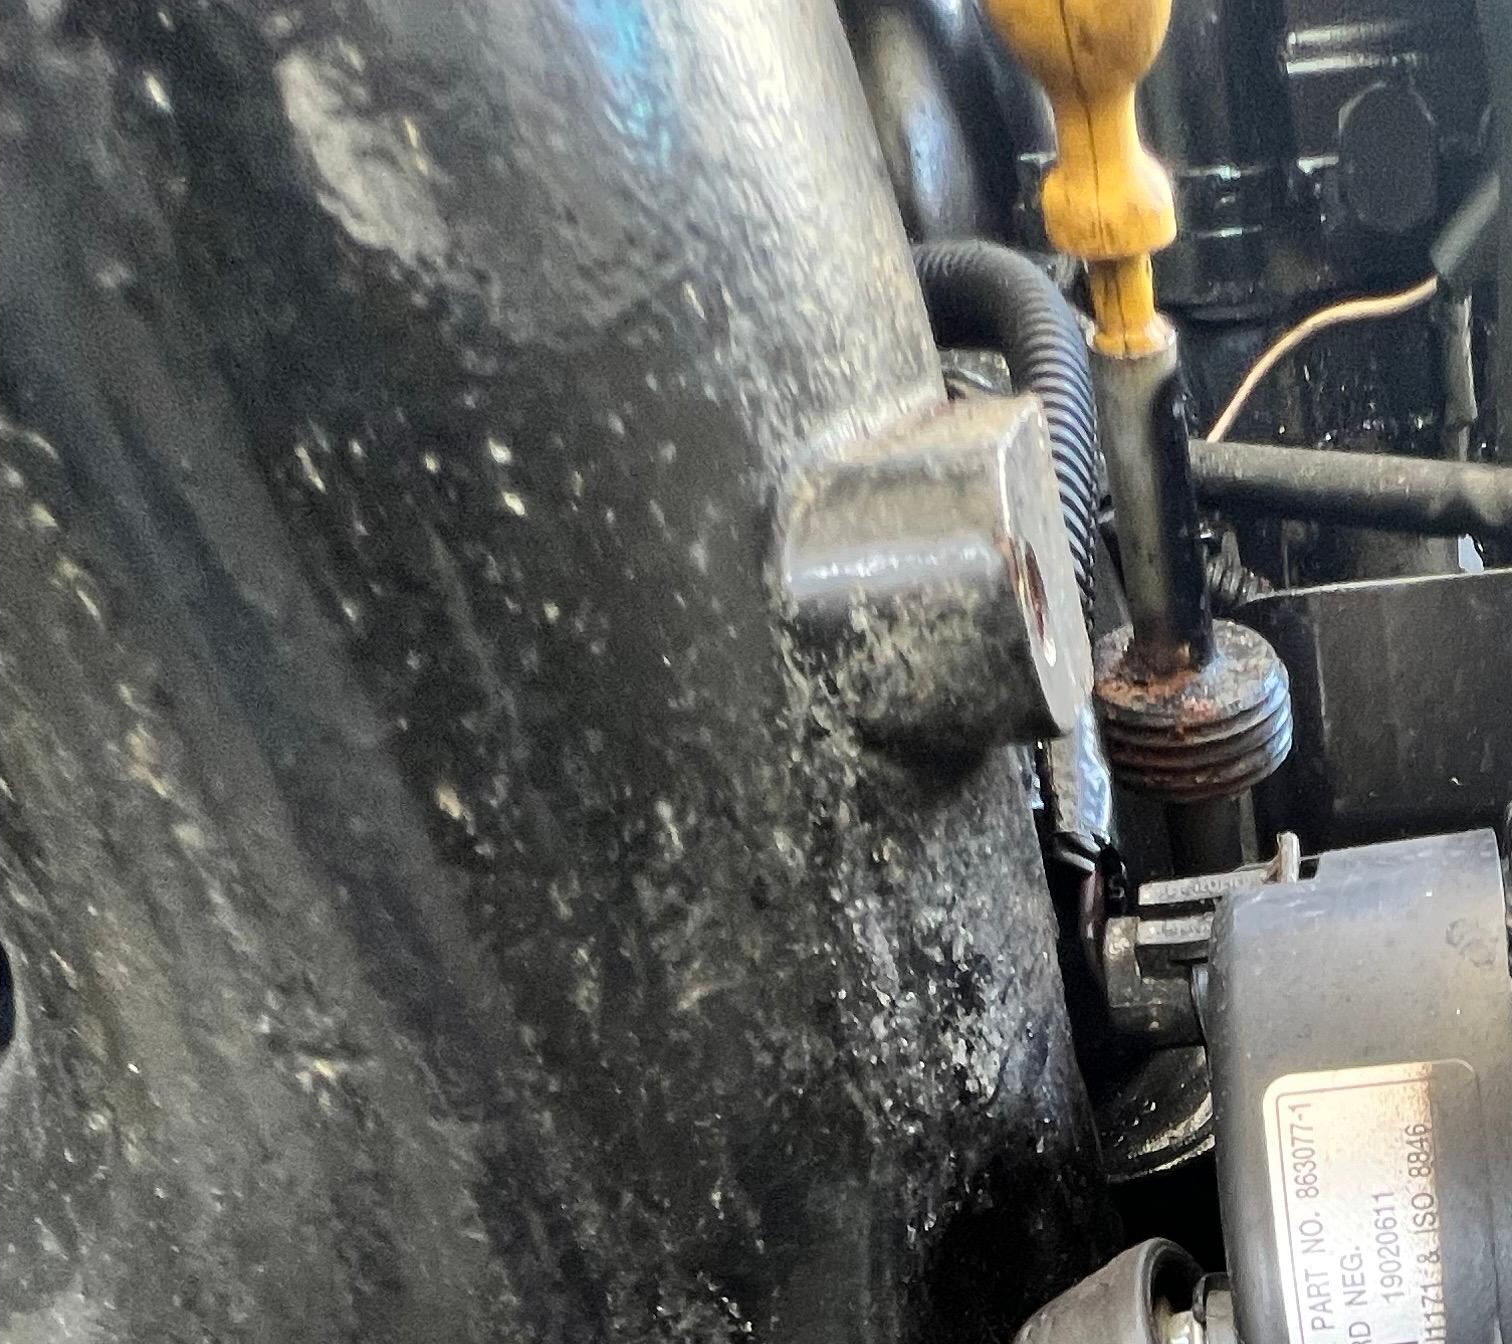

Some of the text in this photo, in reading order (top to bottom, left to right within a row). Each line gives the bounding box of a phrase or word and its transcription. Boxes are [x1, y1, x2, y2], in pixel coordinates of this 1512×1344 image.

[1286, 1099, 1324, 1199] 863077-1
[1404, 1122, 1433, 1178] 8846
[1295, 1210, 1328, 1255] NO.
[1410, 1190, 1439, 1234] ISO
[1371, 1188, 1406, 1302] 19020611
[1416, 1247, 1441, 1264] &
[1305, 1268, 1341, 1329] PART
[1340, 1244, 1370, 1307] NEG.
